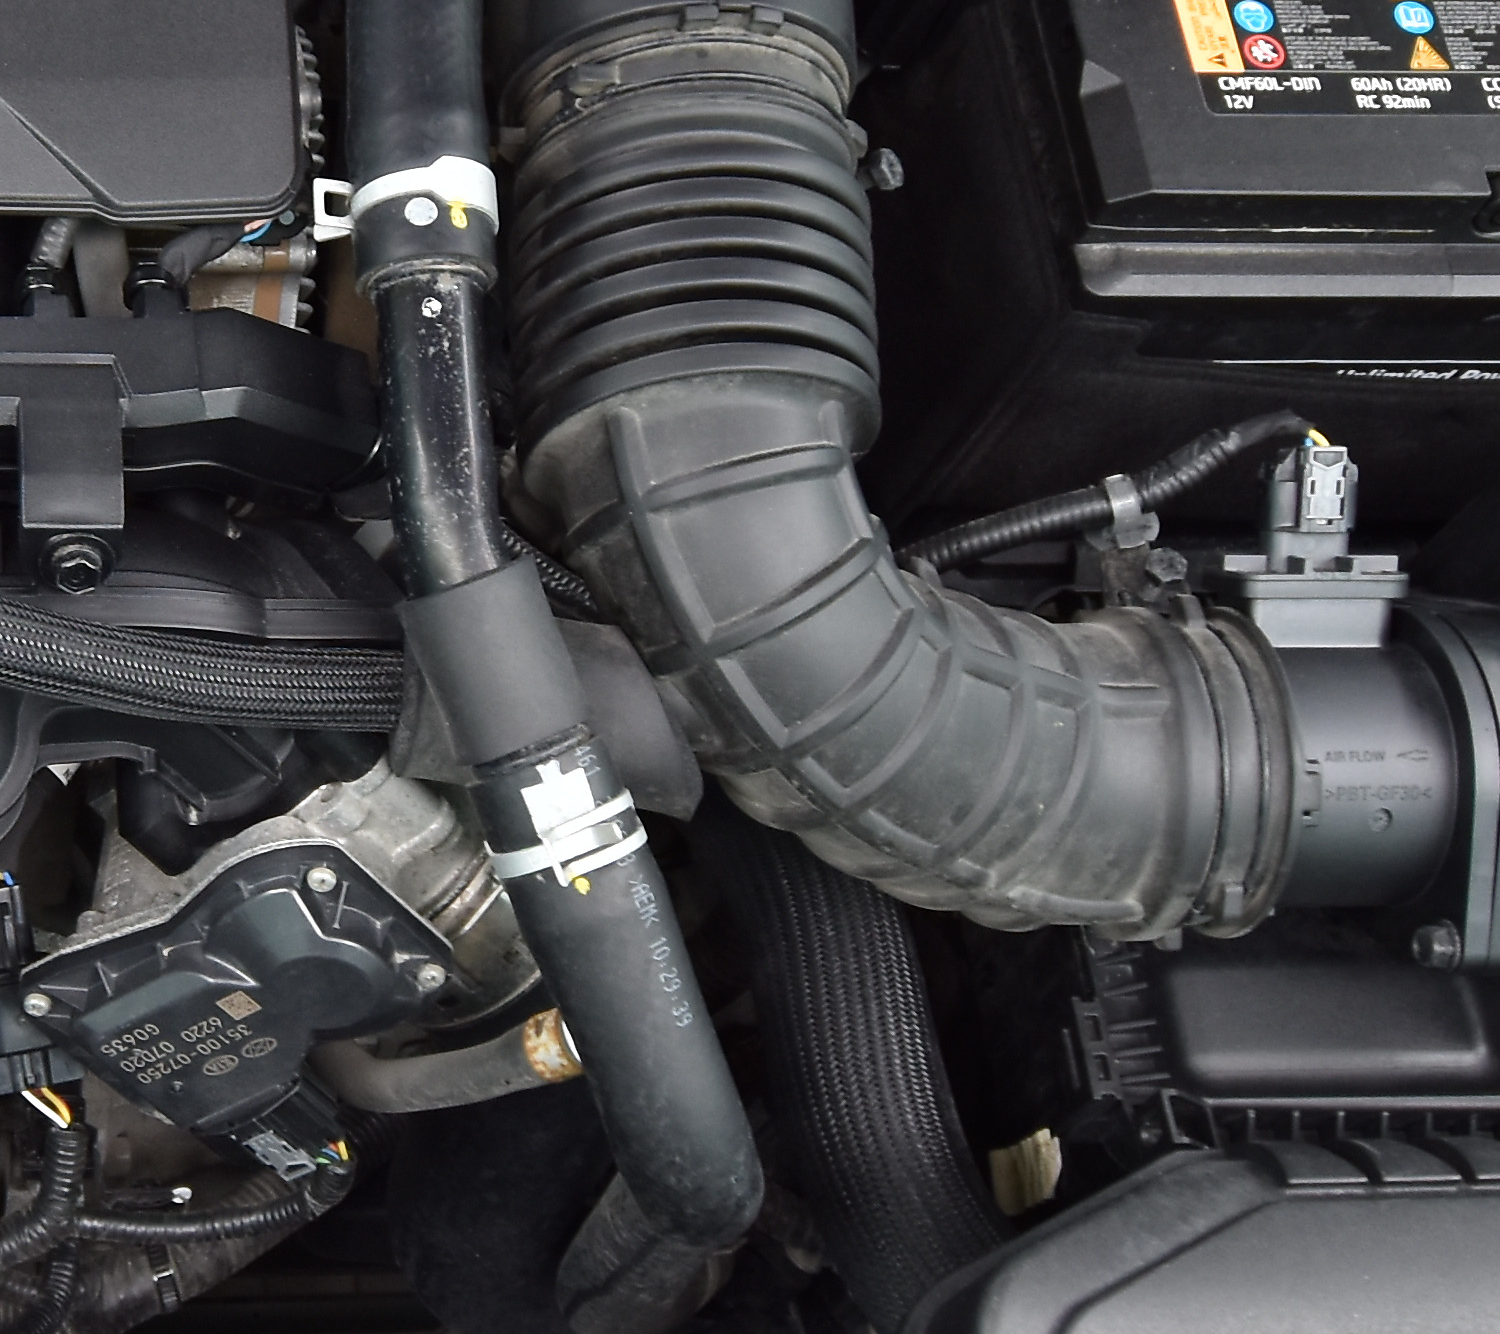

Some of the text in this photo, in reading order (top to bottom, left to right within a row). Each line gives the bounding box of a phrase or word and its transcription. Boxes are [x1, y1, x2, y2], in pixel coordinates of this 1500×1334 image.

[1350, 77, 1394, 92] 60Ah
[1396, 77, 1452, 93] (20HR)
[1223, 94, 1254, 110] 12V
[1355, 94, 1381, 109] RC
[1382, 94, 1432, 109] 92min
[179, 1016, 224, 1044] 6220
[136, 1023, 254, 1086] 35100-07250
